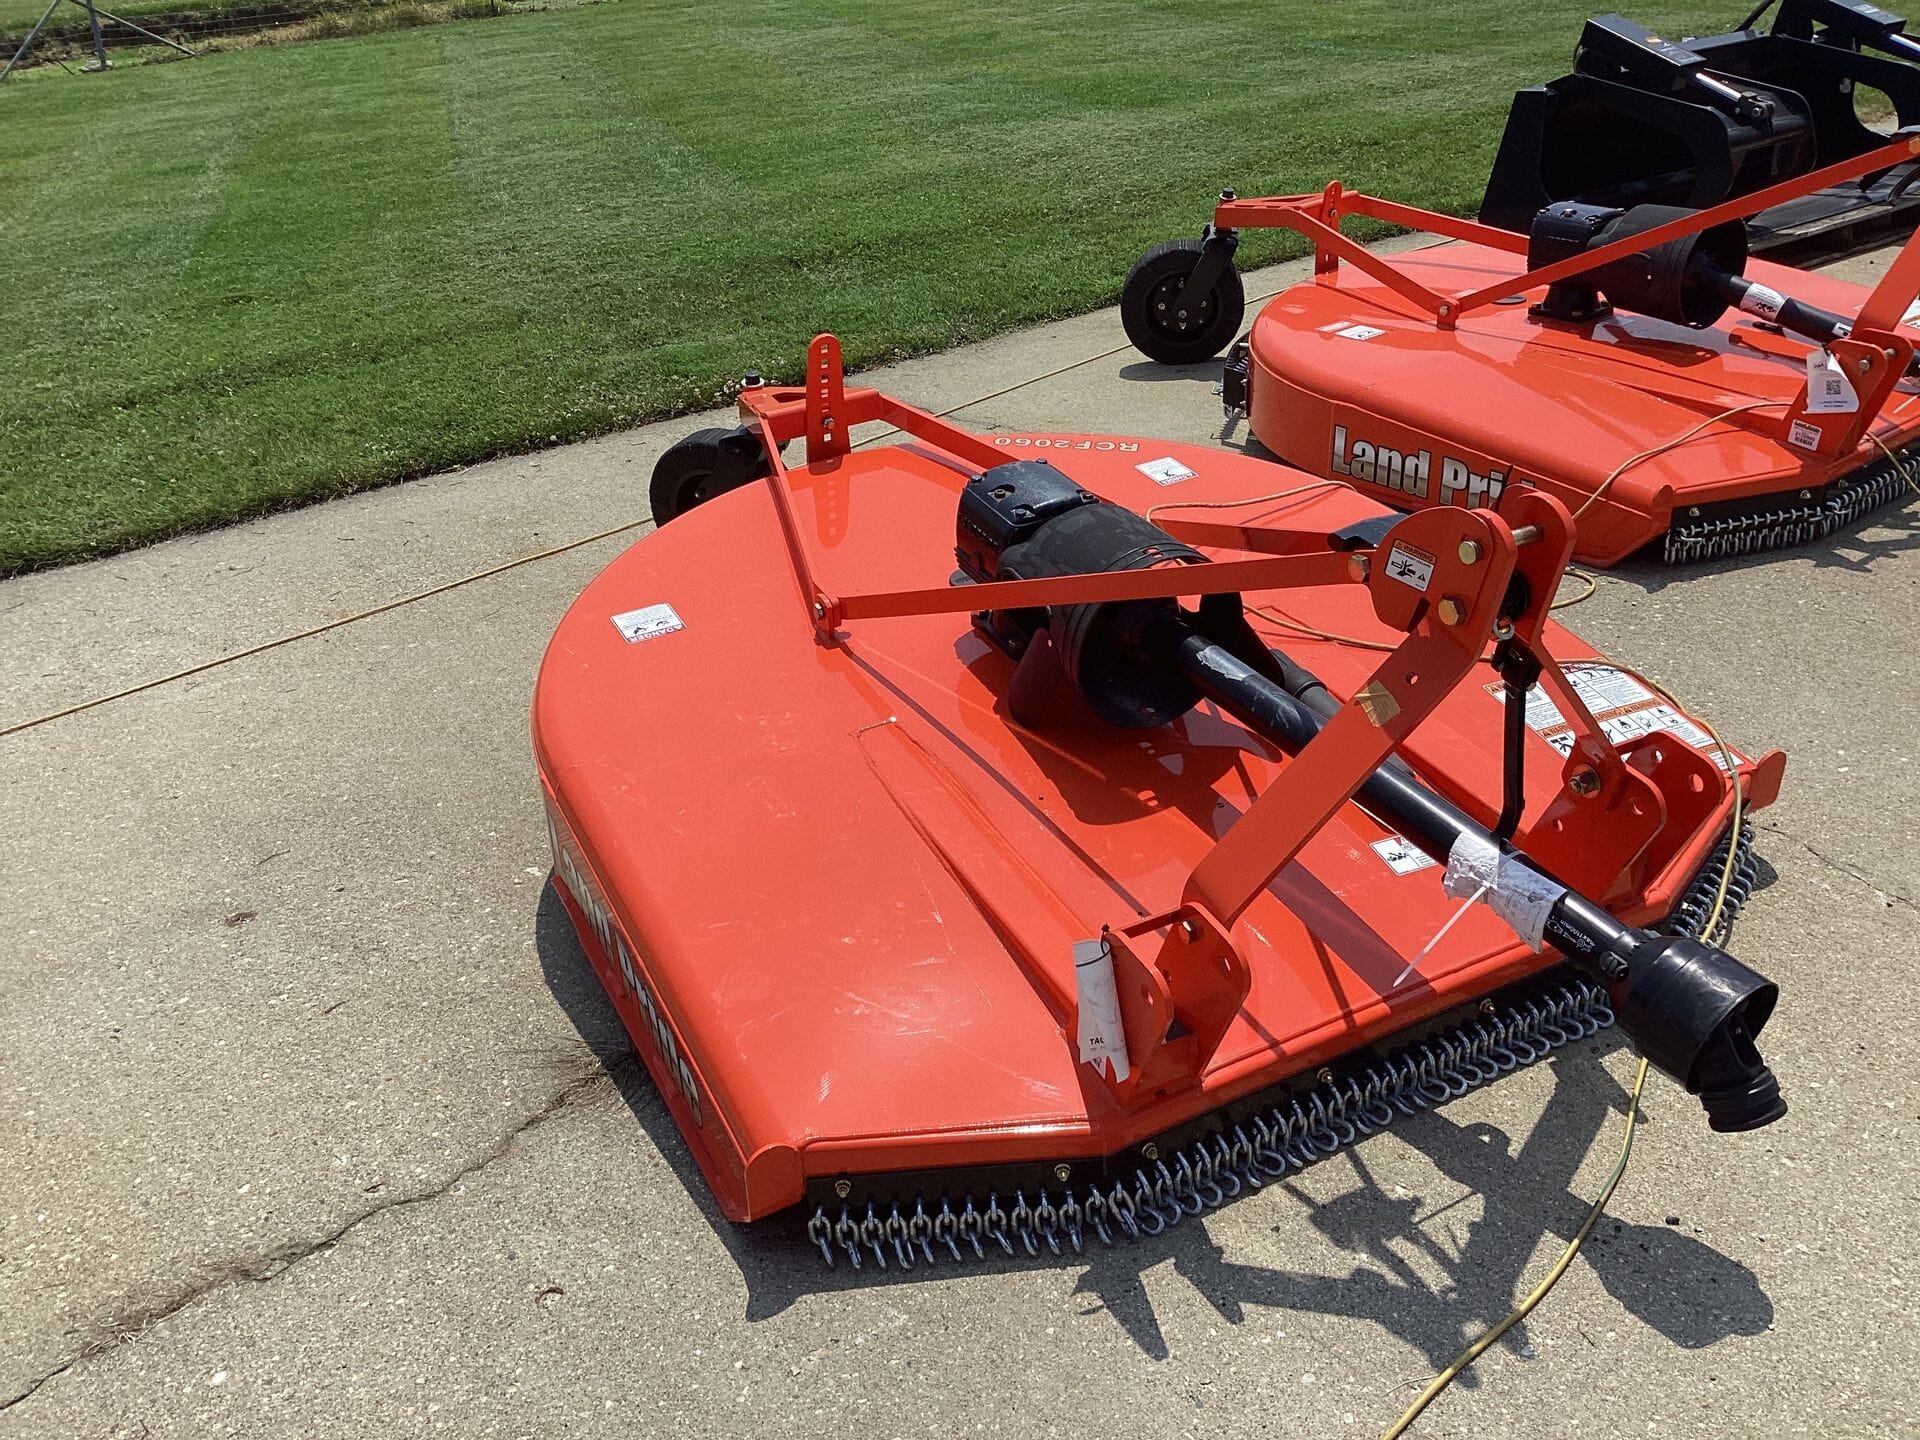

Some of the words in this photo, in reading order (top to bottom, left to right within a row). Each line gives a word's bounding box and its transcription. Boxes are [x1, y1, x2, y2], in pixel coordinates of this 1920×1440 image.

[993, 437, 1141, 452] RCF2060
[1331, 424, 1432, 499] Land
[1439, 455, 1536, 512] Pri
[629, 626, 675, 643] DANGER
[547, 811, 617, 971] Land
[613, 930, 704, 1129] Pride
